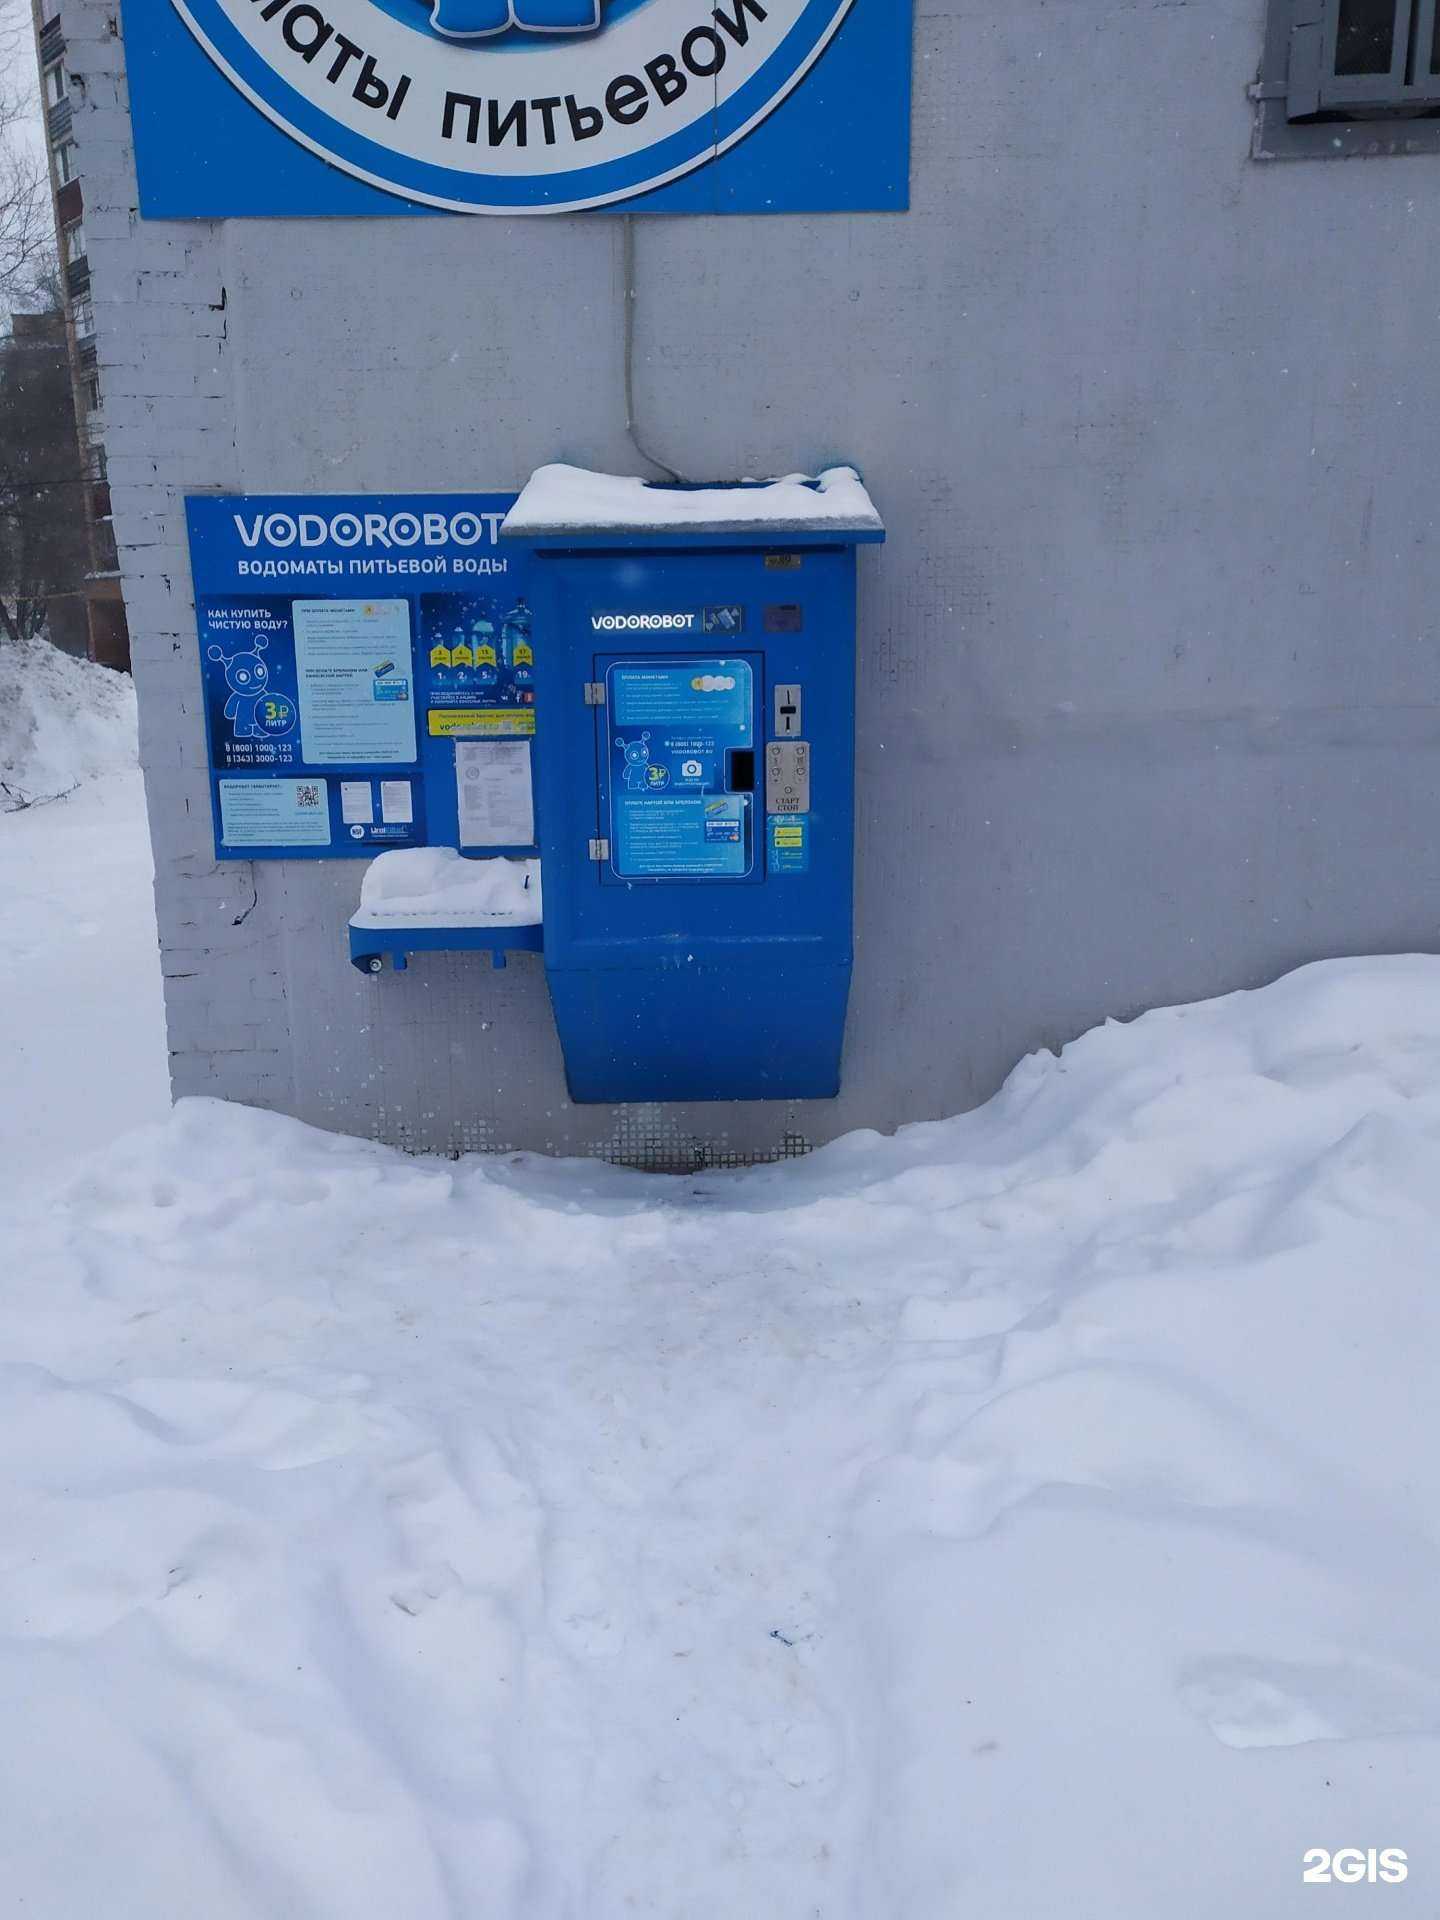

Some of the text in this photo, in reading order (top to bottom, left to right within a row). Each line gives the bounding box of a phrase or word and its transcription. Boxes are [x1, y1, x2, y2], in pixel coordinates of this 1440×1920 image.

[248, 0, 412, 120] аты
[233, 512, 506, 548] VODOROBOT
[238, 555, 508, 577] ВОДОМАТЫ ПИТЬЕВОЙ ВОДЫ
[208, 609, 272, 618] КАК КУПИТЬ
[592, 614, 695, 630] VODOROBOT
[208, 620, 288, 630] ЧИСТУЮ ВОДУ?
